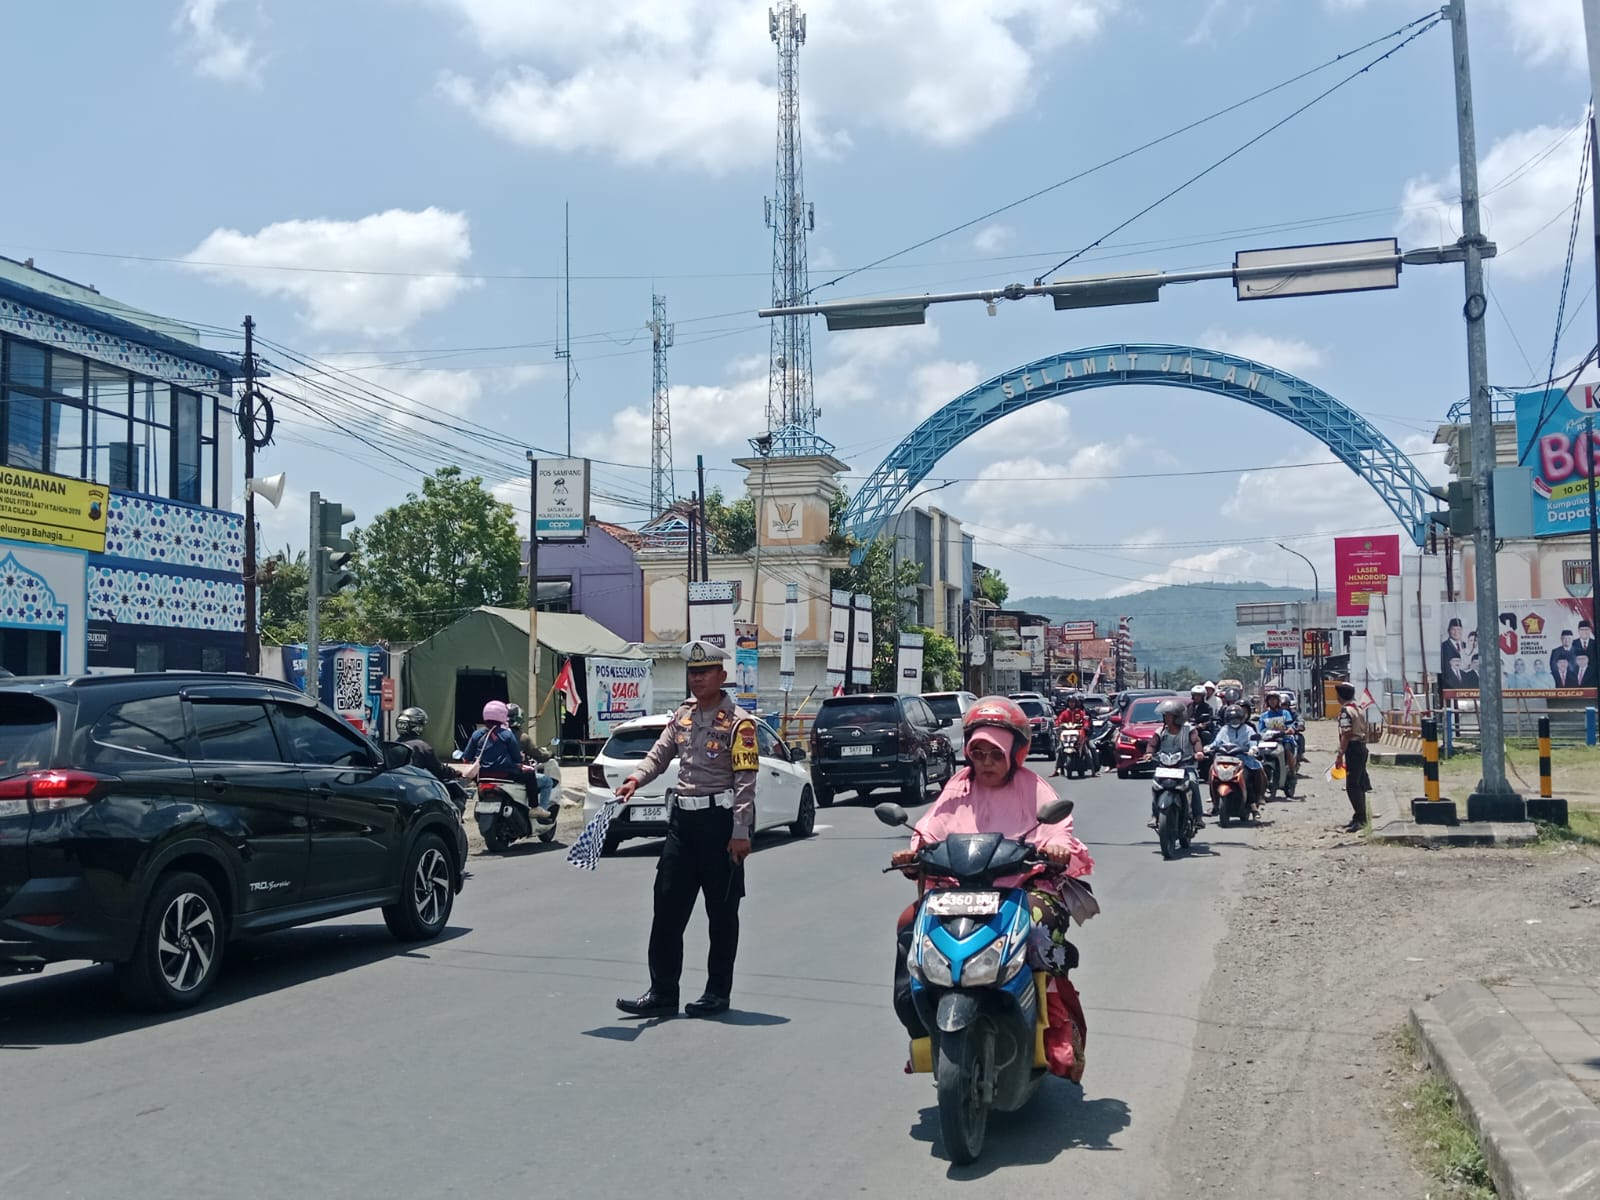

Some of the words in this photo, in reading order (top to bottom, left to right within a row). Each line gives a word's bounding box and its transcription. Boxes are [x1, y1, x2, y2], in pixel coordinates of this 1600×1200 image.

[1001, 354, 1138, 399] SELAMAT
[1160, 354, 1261, 391] JALAN
[553, 469, 582, 477] SAMPANG
[1563, 486, 1573, 495] 10
[1575, 480, 1600, 493] OKO
[10, 489, 34, 499] RANGKA
[18, 498, 30, 506] FITRI
[1547, 497, 1590, 510] Kumpulka
[12, 506, 37, 516] CILACAP
[88, 633, 107, 642] SUKUN
[596, 665, 609, 678] POS
[610, 666, 647, 679] KESEHATAN
[706, 731, 729, 741] POLRI
